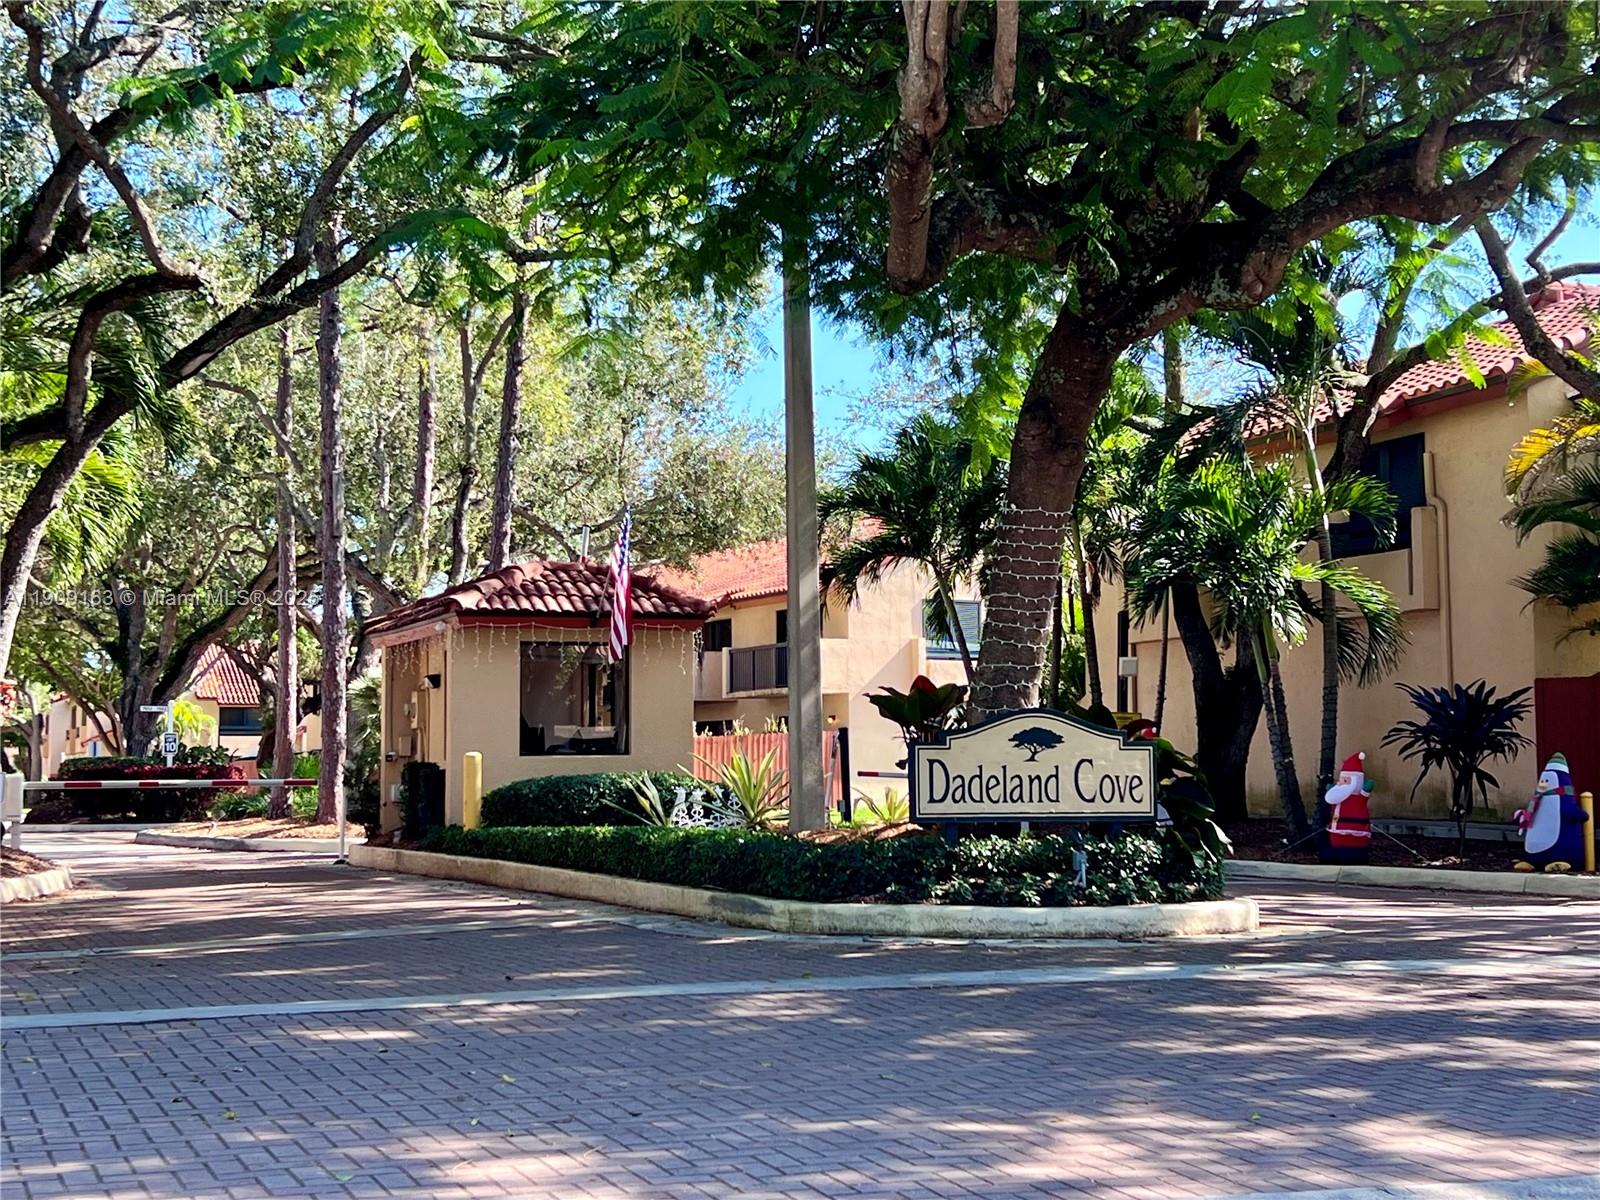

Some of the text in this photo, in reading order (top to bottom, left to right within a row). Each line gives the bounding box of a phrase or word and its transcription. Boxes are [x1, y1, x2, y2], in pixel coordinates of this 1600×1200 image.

[165, 742, 176, 752] 10
[926, 758, 1144, 804] Dadeland Cove
